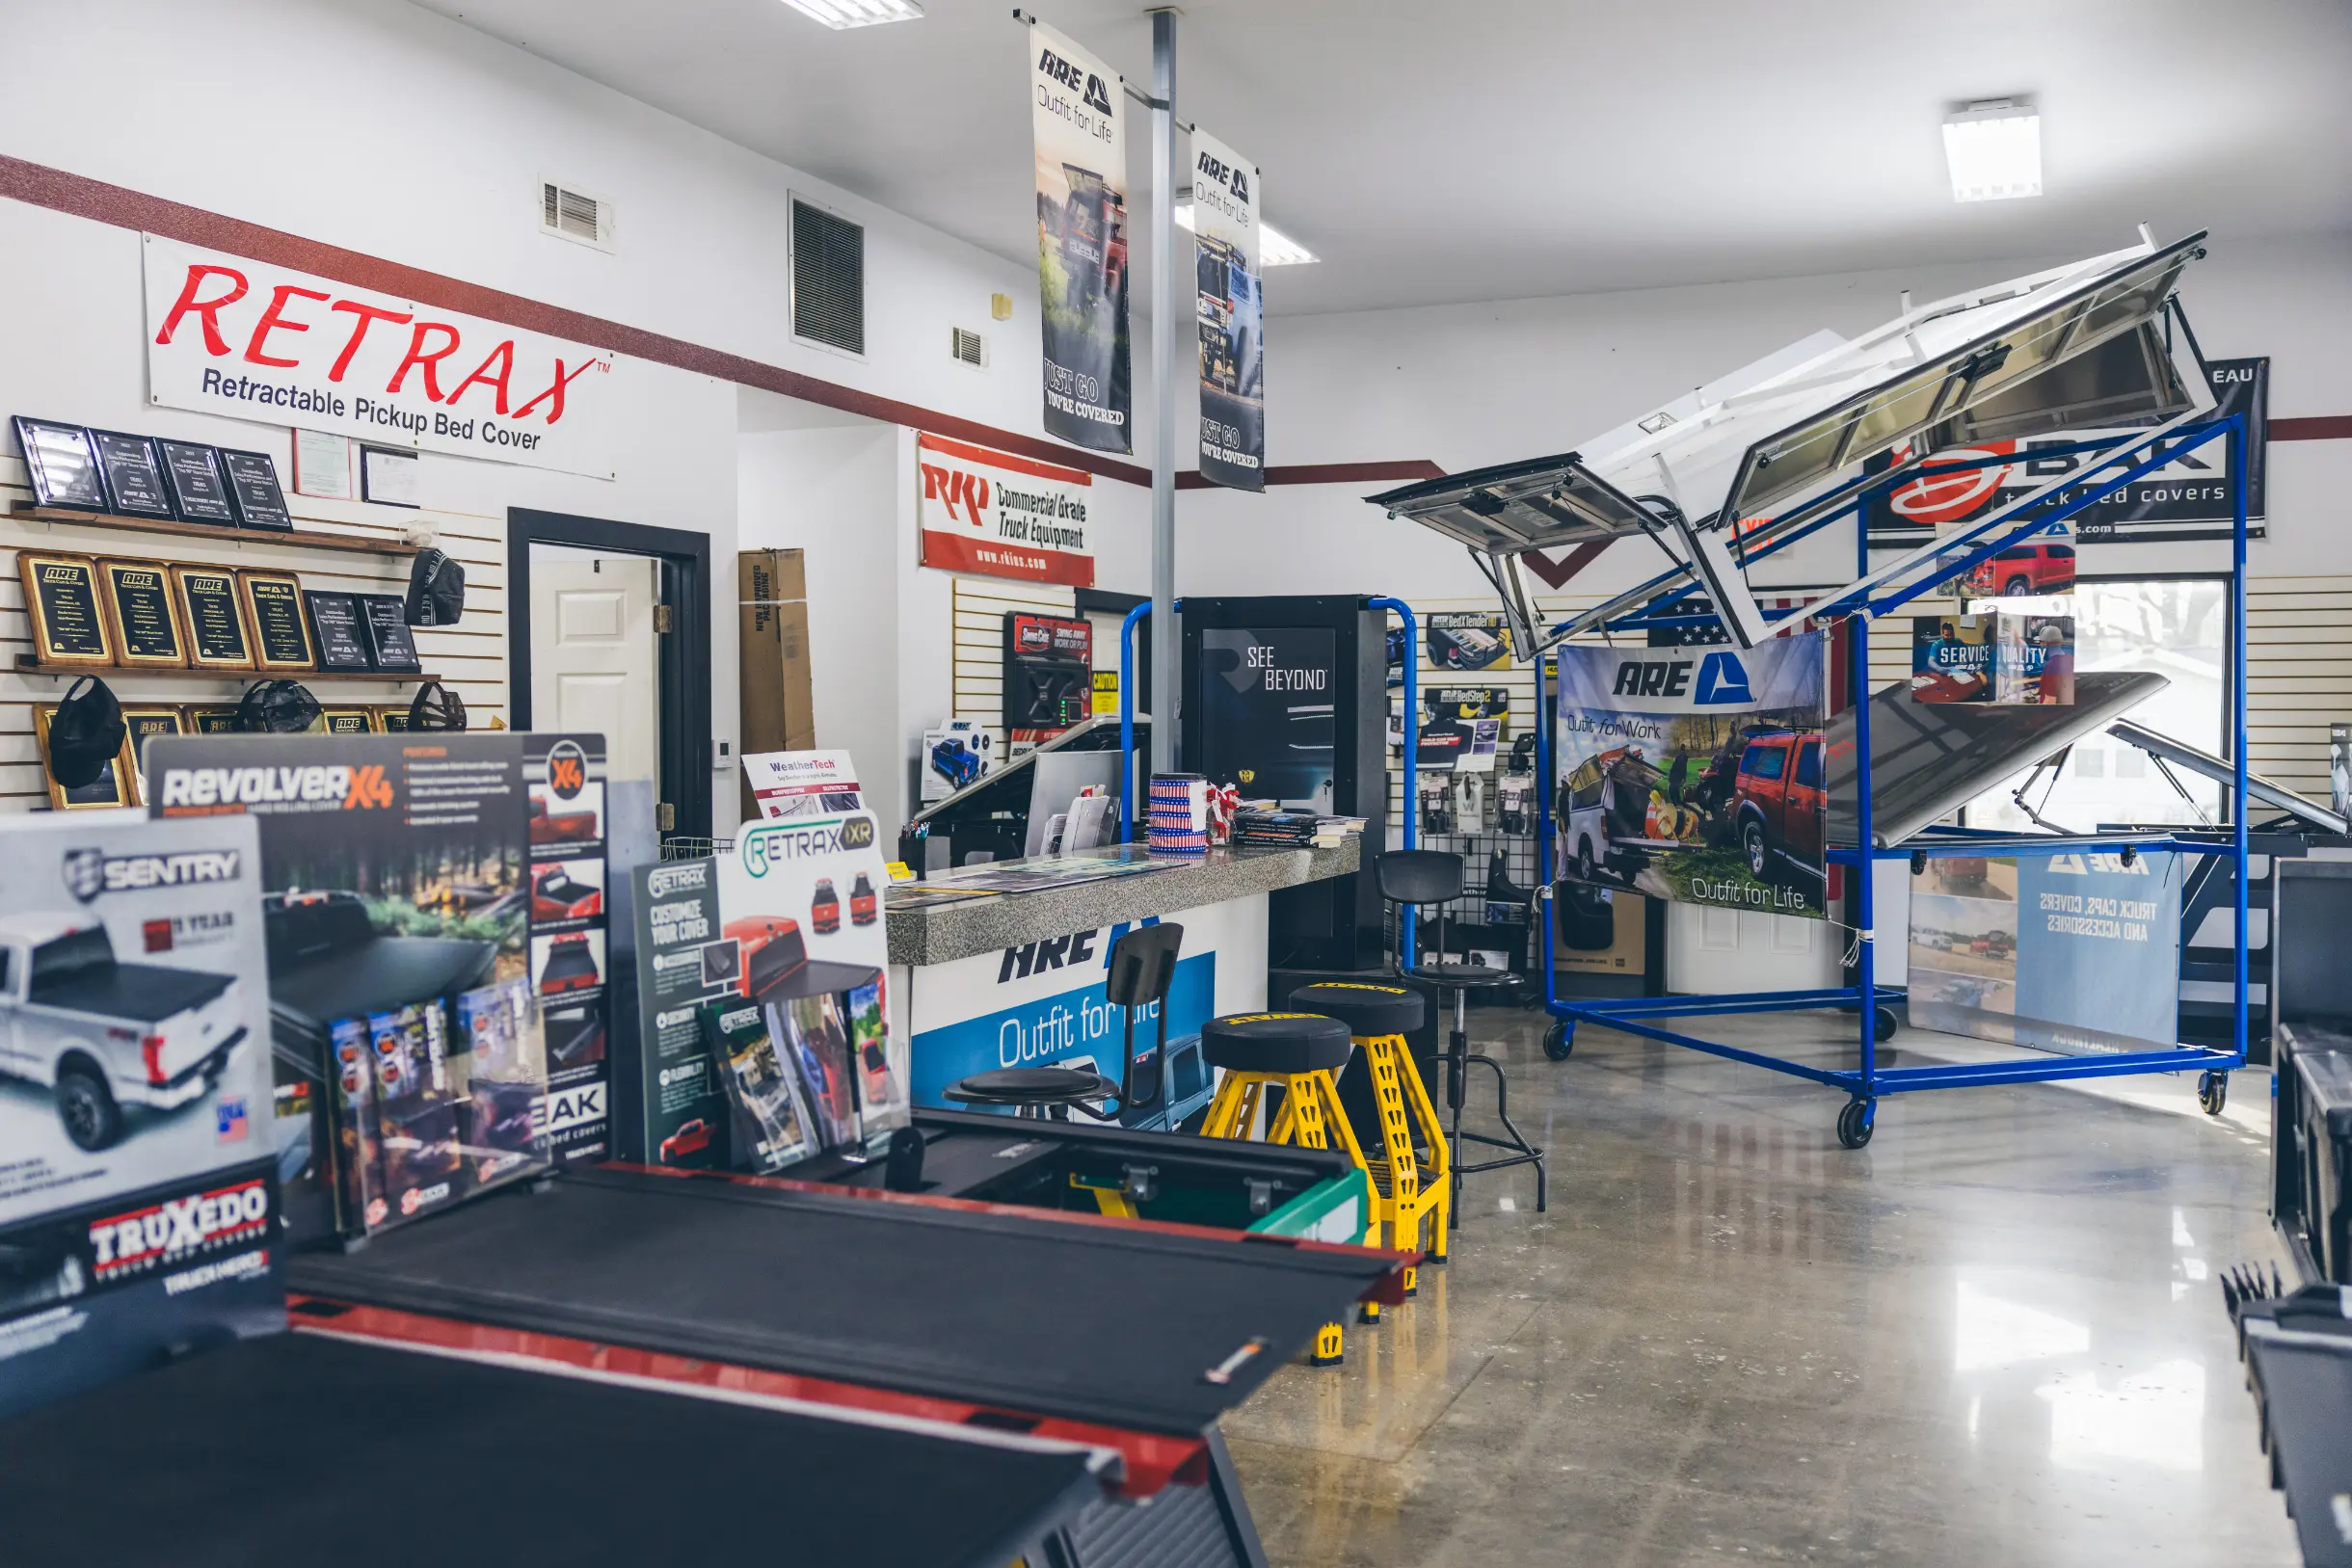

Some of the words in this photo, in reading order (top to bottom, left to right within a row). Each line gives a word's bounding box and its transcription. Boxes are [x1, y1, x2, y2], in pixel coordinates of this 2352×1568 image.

[1038, 48, 1082, 92] ARE
[1038, 85, 1072, 121] Outfit
[1075, 108, 1090, 131] for
[1092, 116, 1112, 144] Life
[1197, 150, 1230, 185] ARE
[1196, 181, 1221, 209] Outfit
[1223, 200, 1235, 219] for
[1236, 207, 1248, 228] Life
[155, 265, 596, 424] RETRAX
[1076, 374, 1098, 402] GO
[202, 368, 345, 416] Retractable
[355, 397, 427, 436] Pickup
[435, 412, 474, 439] Bed
[482, 421, 541, 450] Cover
[1047, 391, 1074, 414] YOU'RE
[1076, 401, 1124, 426] COVERED
[1222, 425, 1241, 449] GO
[1222, 448, 1258, 468] COVERED
[996, 481, 1057, 518] Commercial
[1058, 494, 1086, 522] Grade
[2005, 490, 2070, 506] tck
[2141, 486, 2225, 503] covers
[999, 511, 1028, 541] Truck
[1031, 518, 1083, 550] Equipment
[976, 549, 1047, 571] www.rkius.com
[1054, 638, 1070, 649] WORK
[1070, 640, 1077, 649] OR
[1077, 640, 1088, 651] PLAY
[1056, 627, 1073, 638] SWING
[1073, 629, 1086, 640] AWAY
[1247, 647, 1274, 668] SEE
[1940, 646, 1990, 663] SERVICE
[1093, 673, 1118, 690] CAUTION
[1265, 669, 1326, 691] BEYOND
[1613, 660, 1695, 697] ARE
[1567, 714, 1594, 733] Outfit
[1599, 719, 1621, 738] for
[1622, 721, 1661, 740] Work
[769, 759, 836, 772] WeatherTech
[743, 821, 842, 878] RETRAX
[104, 852, 239, 889] SENTRY
[1692, 878, 1741, 904] Outfit
[1745, 883, 1770, 905] for
[1774, 885, 1805, 910] Life
[679, 918, 708, 942] COVER
[1000, 1004, 1074, 1068] Outfit
[1081, 997, 1116, 1042] for
[89, 1186, 267, 1263] TRUXEDO
